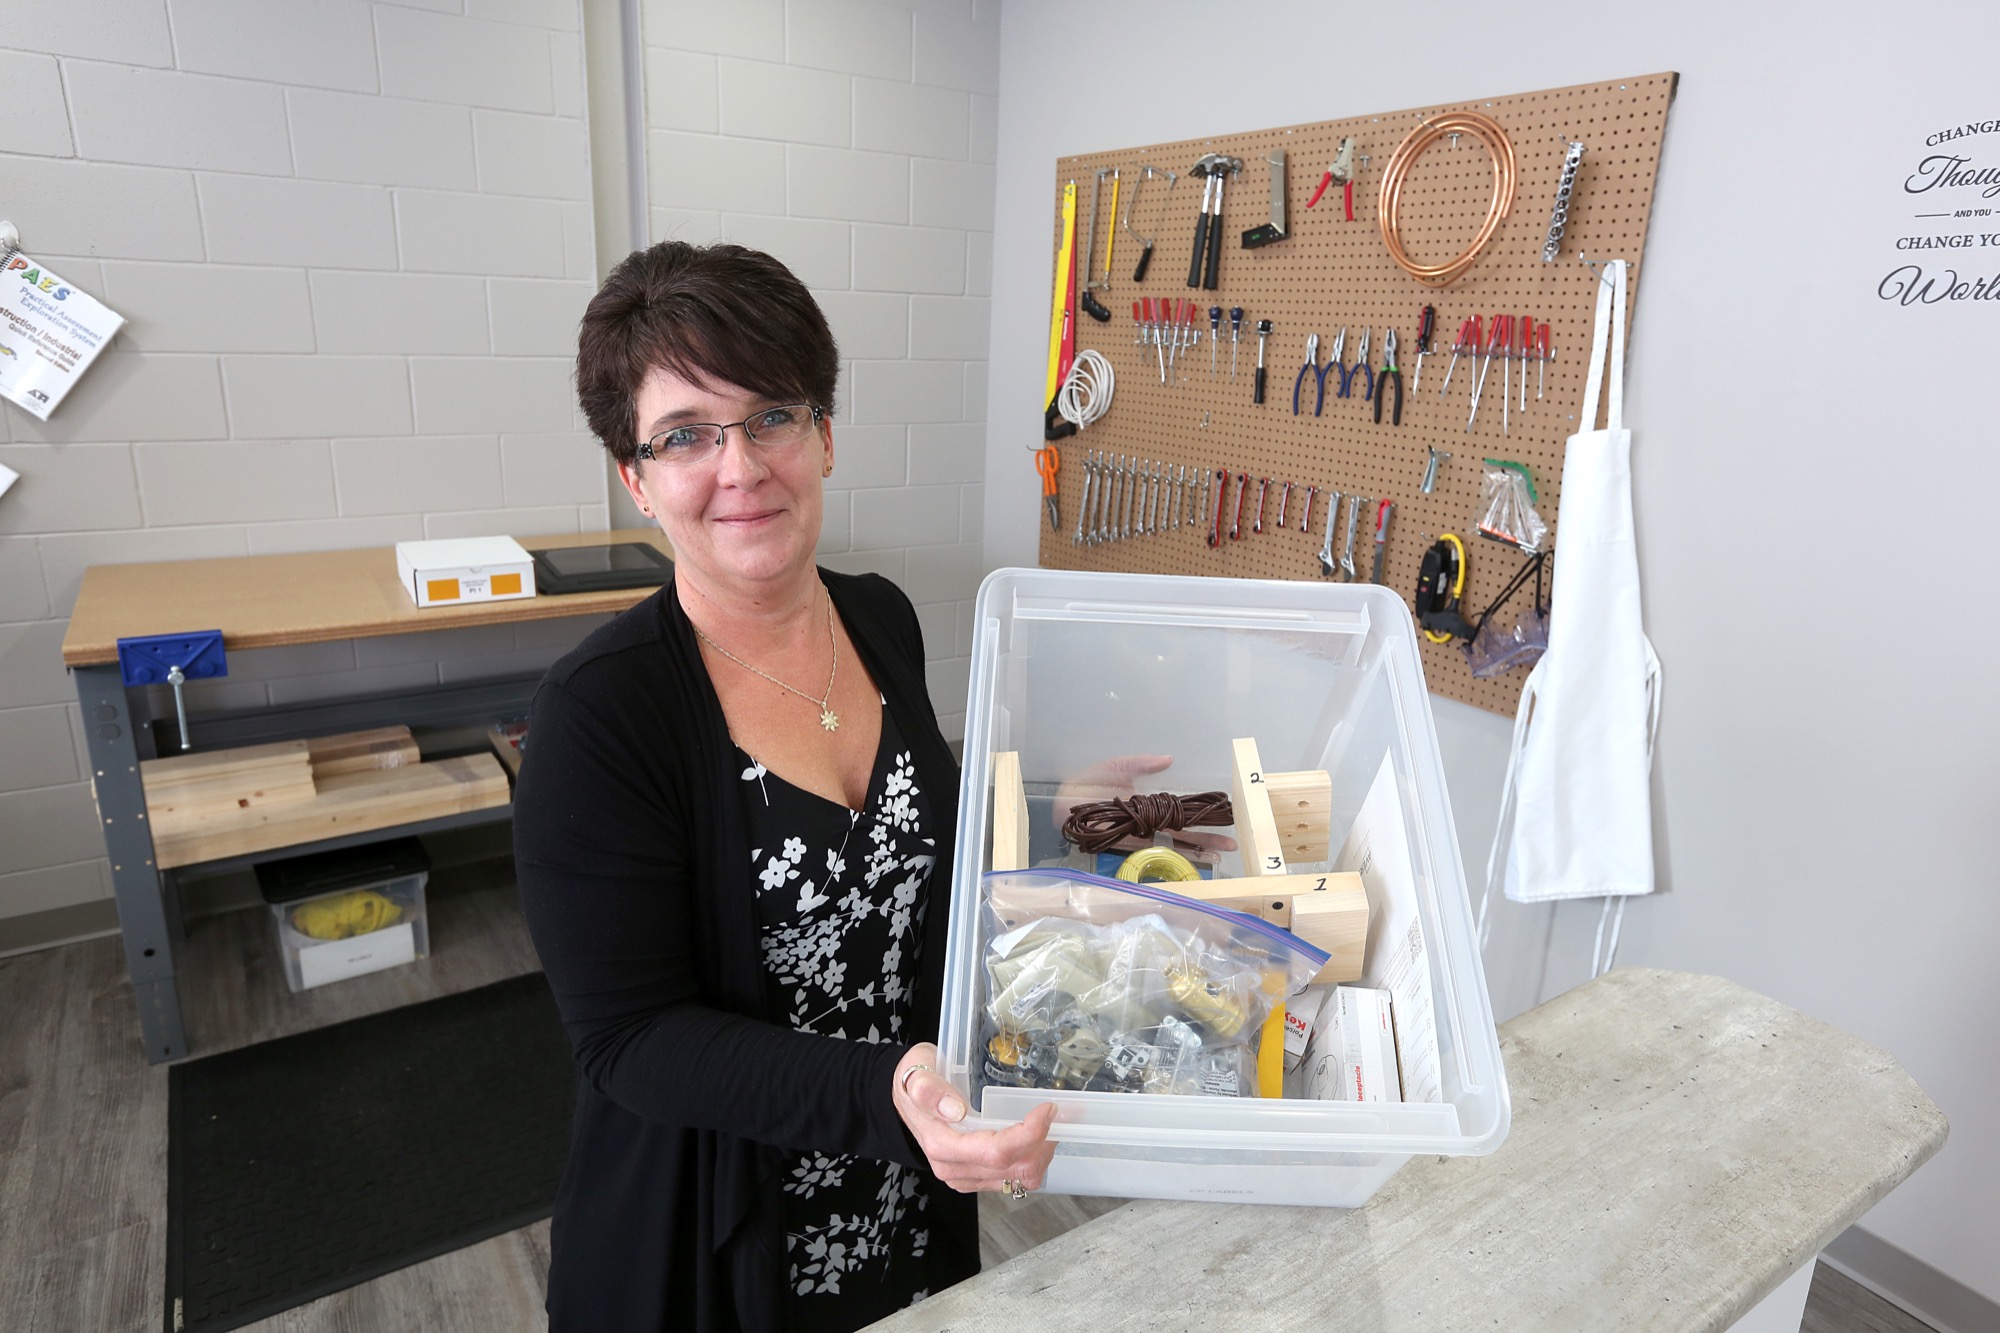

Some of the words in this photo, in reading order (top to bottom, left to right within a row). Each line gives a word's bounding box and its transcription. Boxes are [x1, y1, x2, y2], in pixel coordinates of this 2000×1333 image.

[1953, 210, 1972, 218] AND
[1974, 208, 1992, 217] YOU
[1896, 235, 1974, 250] CHANGE
[7, 257, 71, 301] PAES
[1878, 265, 2000, 306] Worl
[20, 286, 59, 313] Practical
[57, 311, 102, 342] Assessment
[20, 297, 68, 331] Exploration
[69, 328, 96, 348] System
[9, 323, 27, 338] Quick
[43, 333, 82, 361] Industrial
[1250, 772, 1265, 784] 2
[1266, 856, 1282, 869] 3
[1313, 878, 1327, 891] 1
